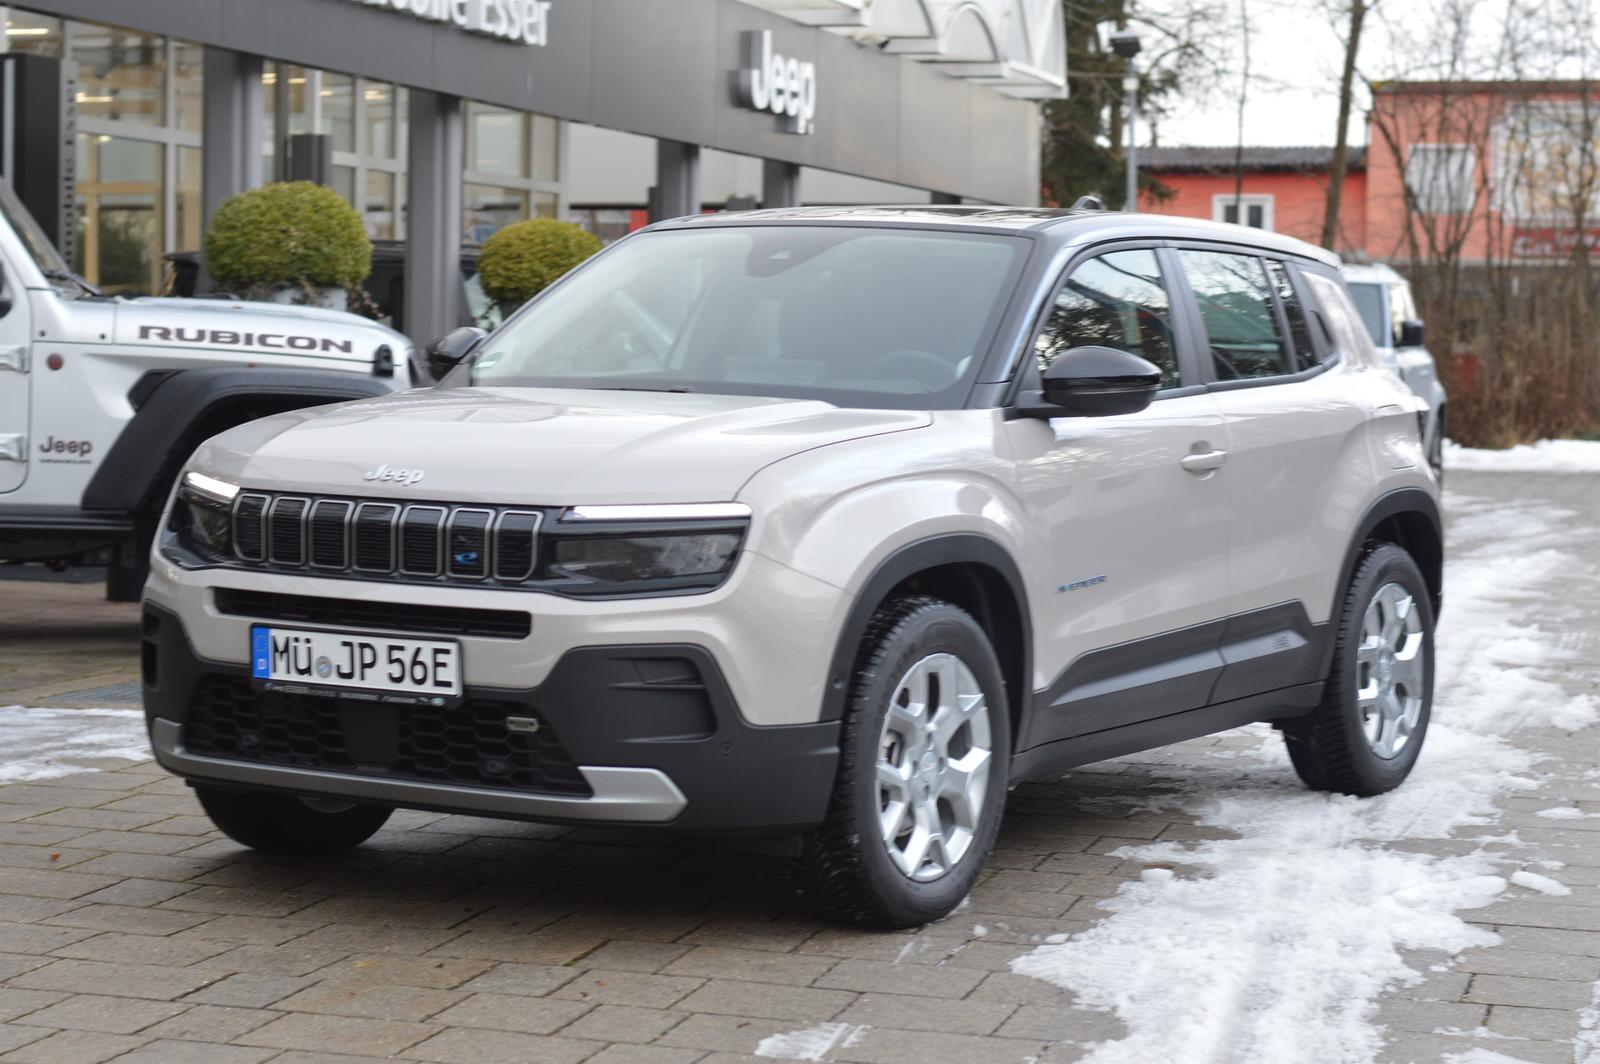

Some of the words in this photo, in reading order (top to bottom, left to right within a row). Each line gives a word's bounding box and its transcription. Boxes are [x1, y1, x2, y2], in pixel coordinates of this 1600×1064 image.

[751, 29, 815, 134] Jeep
[139, 325, 352, 353] RUBICON
[39, 435, 92, 457] Jeep
[363, 464, 425, 487] Jeep
[336, 641, 377, 681] JP
[387, 644, 453, 688] 56E
